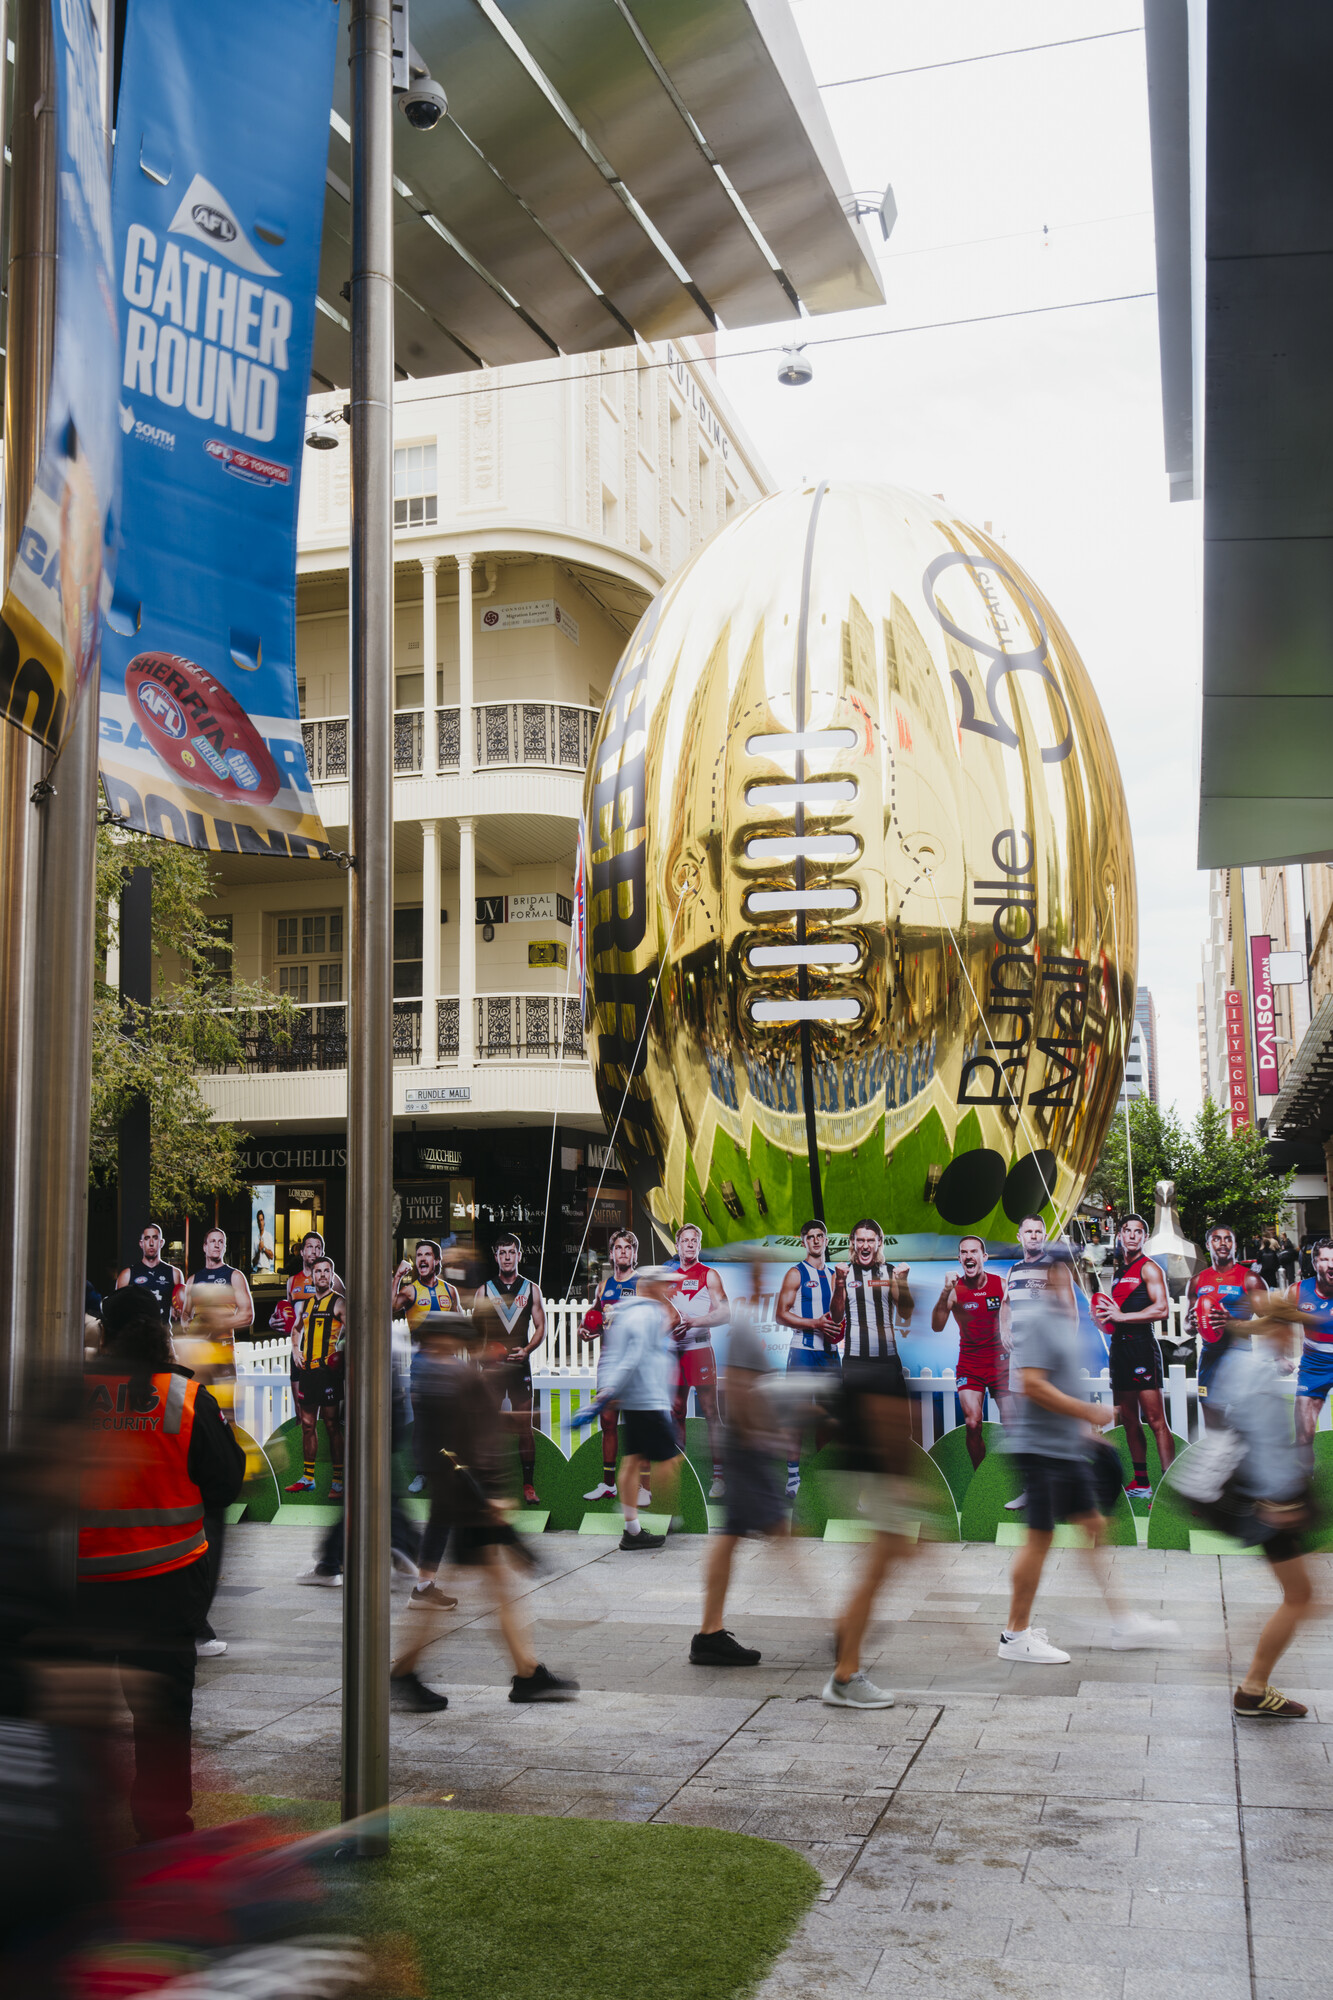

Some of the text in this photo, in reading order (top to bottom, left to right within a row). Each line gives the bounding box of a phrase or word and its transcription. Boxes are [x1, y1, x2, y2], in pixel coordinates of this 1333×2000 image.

[194, 209, 234, 241] AFL
[122, 223, 293, 371] GATHER
[123, 308, 279, 442] ROUND
[135, 421, 175, 446] SOUTH
[249, 459, 287, 479] TOYOTA
[972, 571, 1013, 646] YEARS
[922, 552, 1073, 763] 50
[130, 658, 227, 757] SHERRIN
[140, 687, 182, 737] AFL
[194, 737, 228, 778] ADELAIDE
[229, 755, 258, 788] GATH
[510, 910, 554, 919] FORMAL
[513, 896, 550, 905] BRIDAL
[957, 828, 1036, 1106] Rundle
[1228, 993, 1241, 1051] CITY
[1256, 957, 1276, 1069] DAISO JAPAN
[1028, 955, 1089, 1107] Mall
[418, 1089, 468, 1100] RUNDLE MALL
[1232, 1069, 1246, 1130] CROS
[233, 1148, 347, 1169] ZUCCHELLI'S
[288, 1188, 315, 1198] LONGINES
[406, 1195, 443, 1205] LIMITED
[406, 1205, 443, 1219] TIME
[607, 1209, 622, 1224] EVENT
[1025, 1280, 1047, 1288] Ford
[88, 1417, 160, 1431] ECURITY
